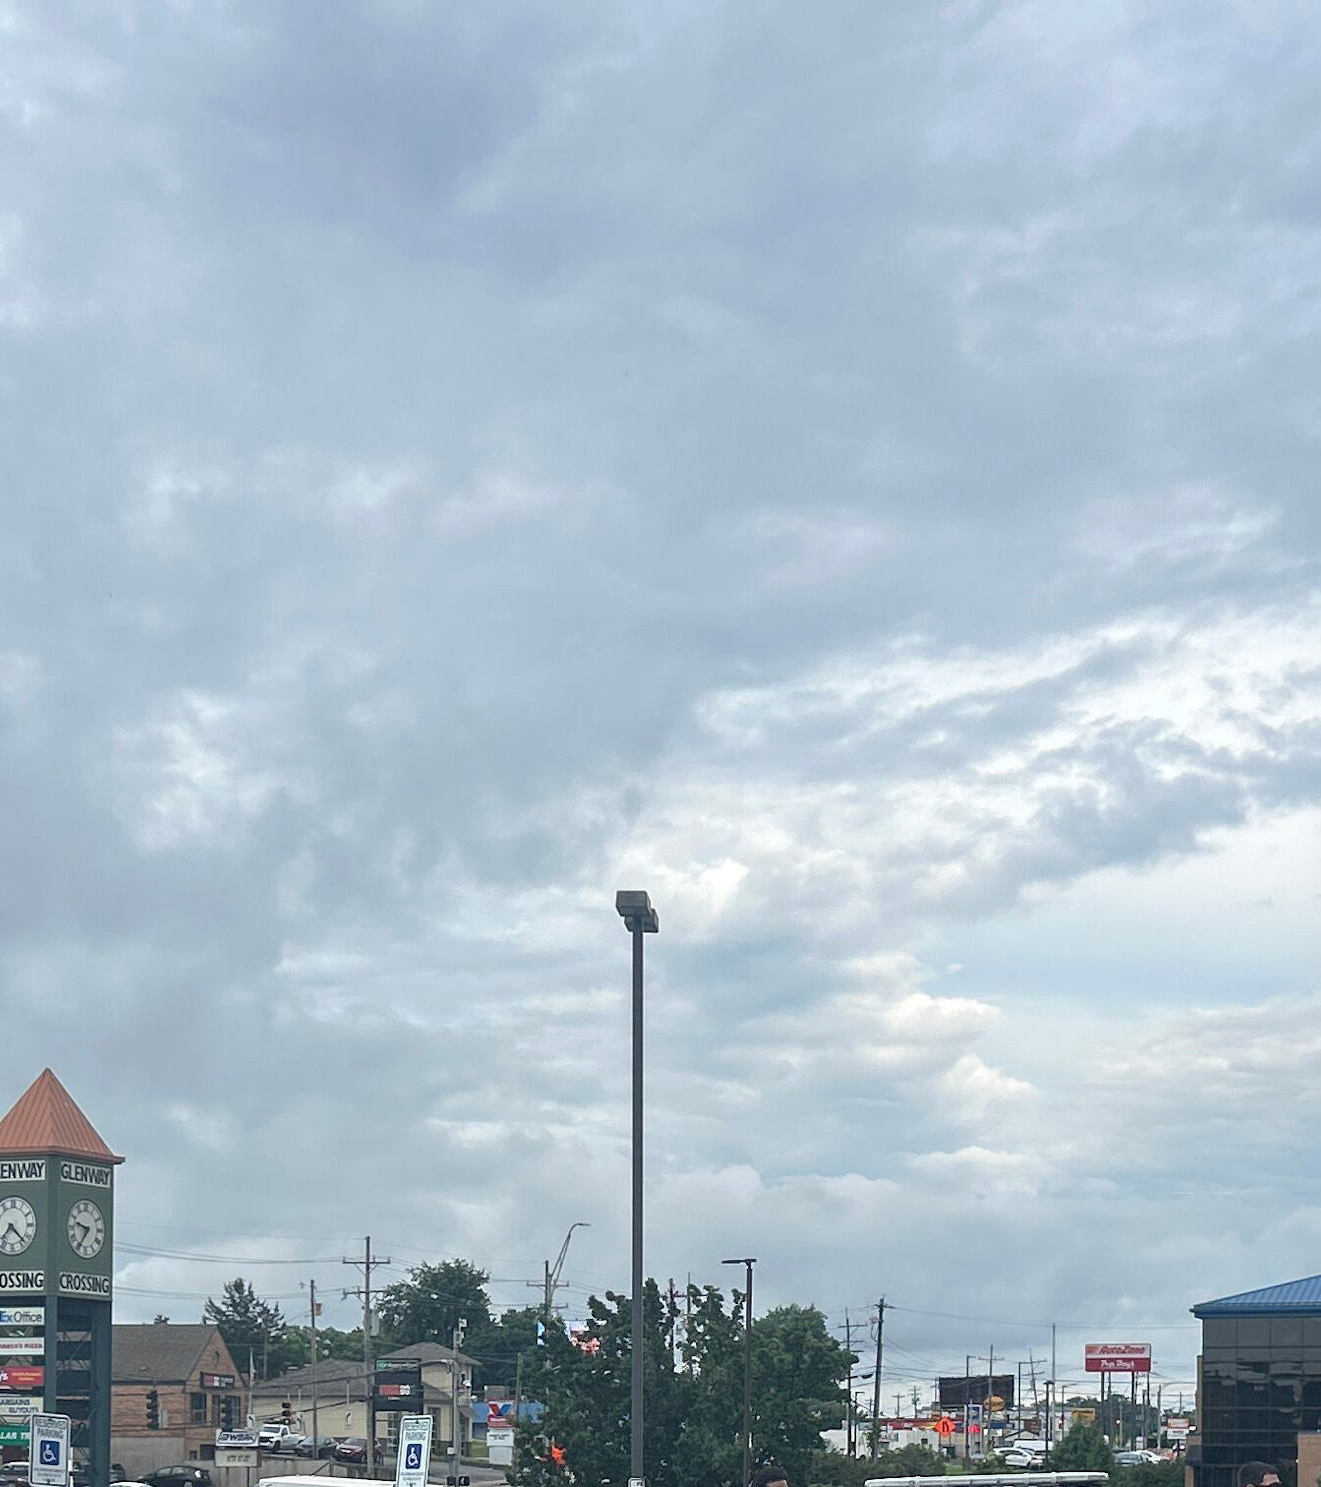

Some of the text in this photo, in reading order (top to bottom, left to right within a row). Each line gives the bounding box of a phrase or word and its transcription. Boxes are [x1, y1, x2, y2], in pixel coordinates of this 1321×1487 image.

[61, 1163, 110, 1185] GLENWAY
[60, 1274, 109, 1293] CROSSING
[14, 1311, 42, 1322] Office
